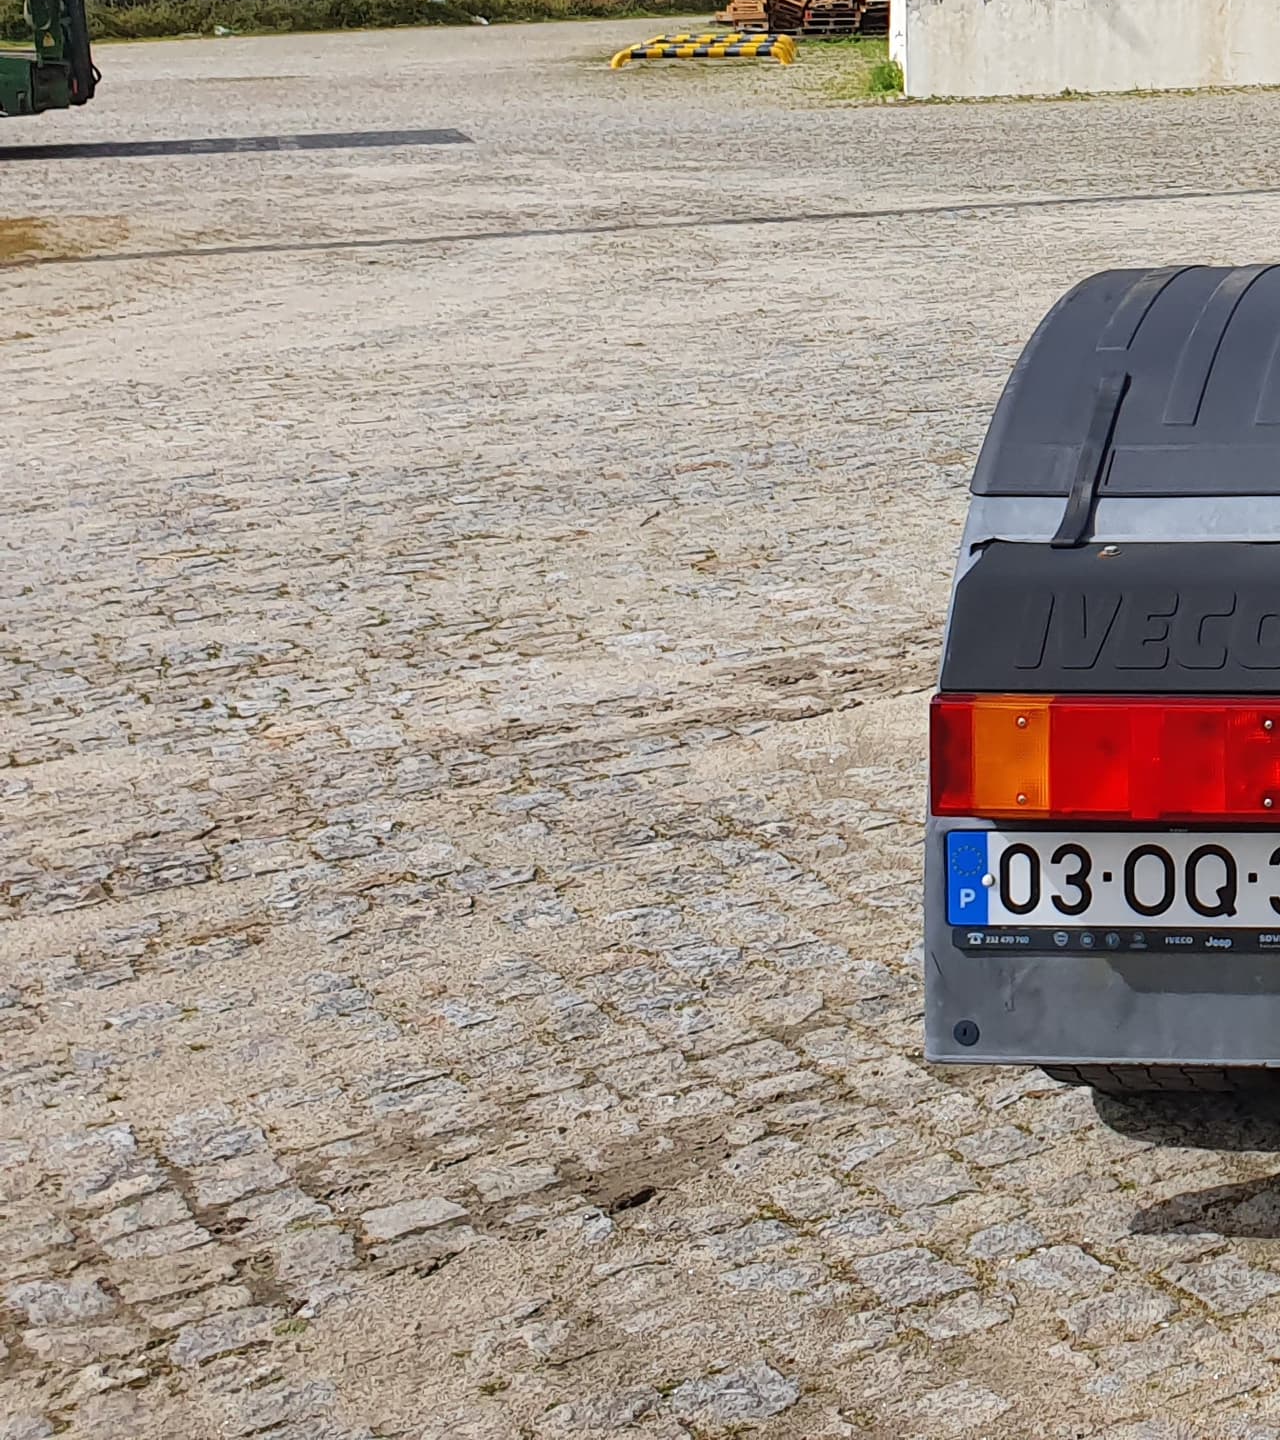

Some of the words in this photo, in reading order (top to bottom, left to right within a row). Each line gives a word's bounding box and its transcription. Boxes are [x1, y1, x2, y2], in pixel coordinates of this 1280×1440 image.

[960, 889, 976, 909] P
[1165, 936, 1194, 944] IVECO
[1205, 936, 1232, 948] Jeep
